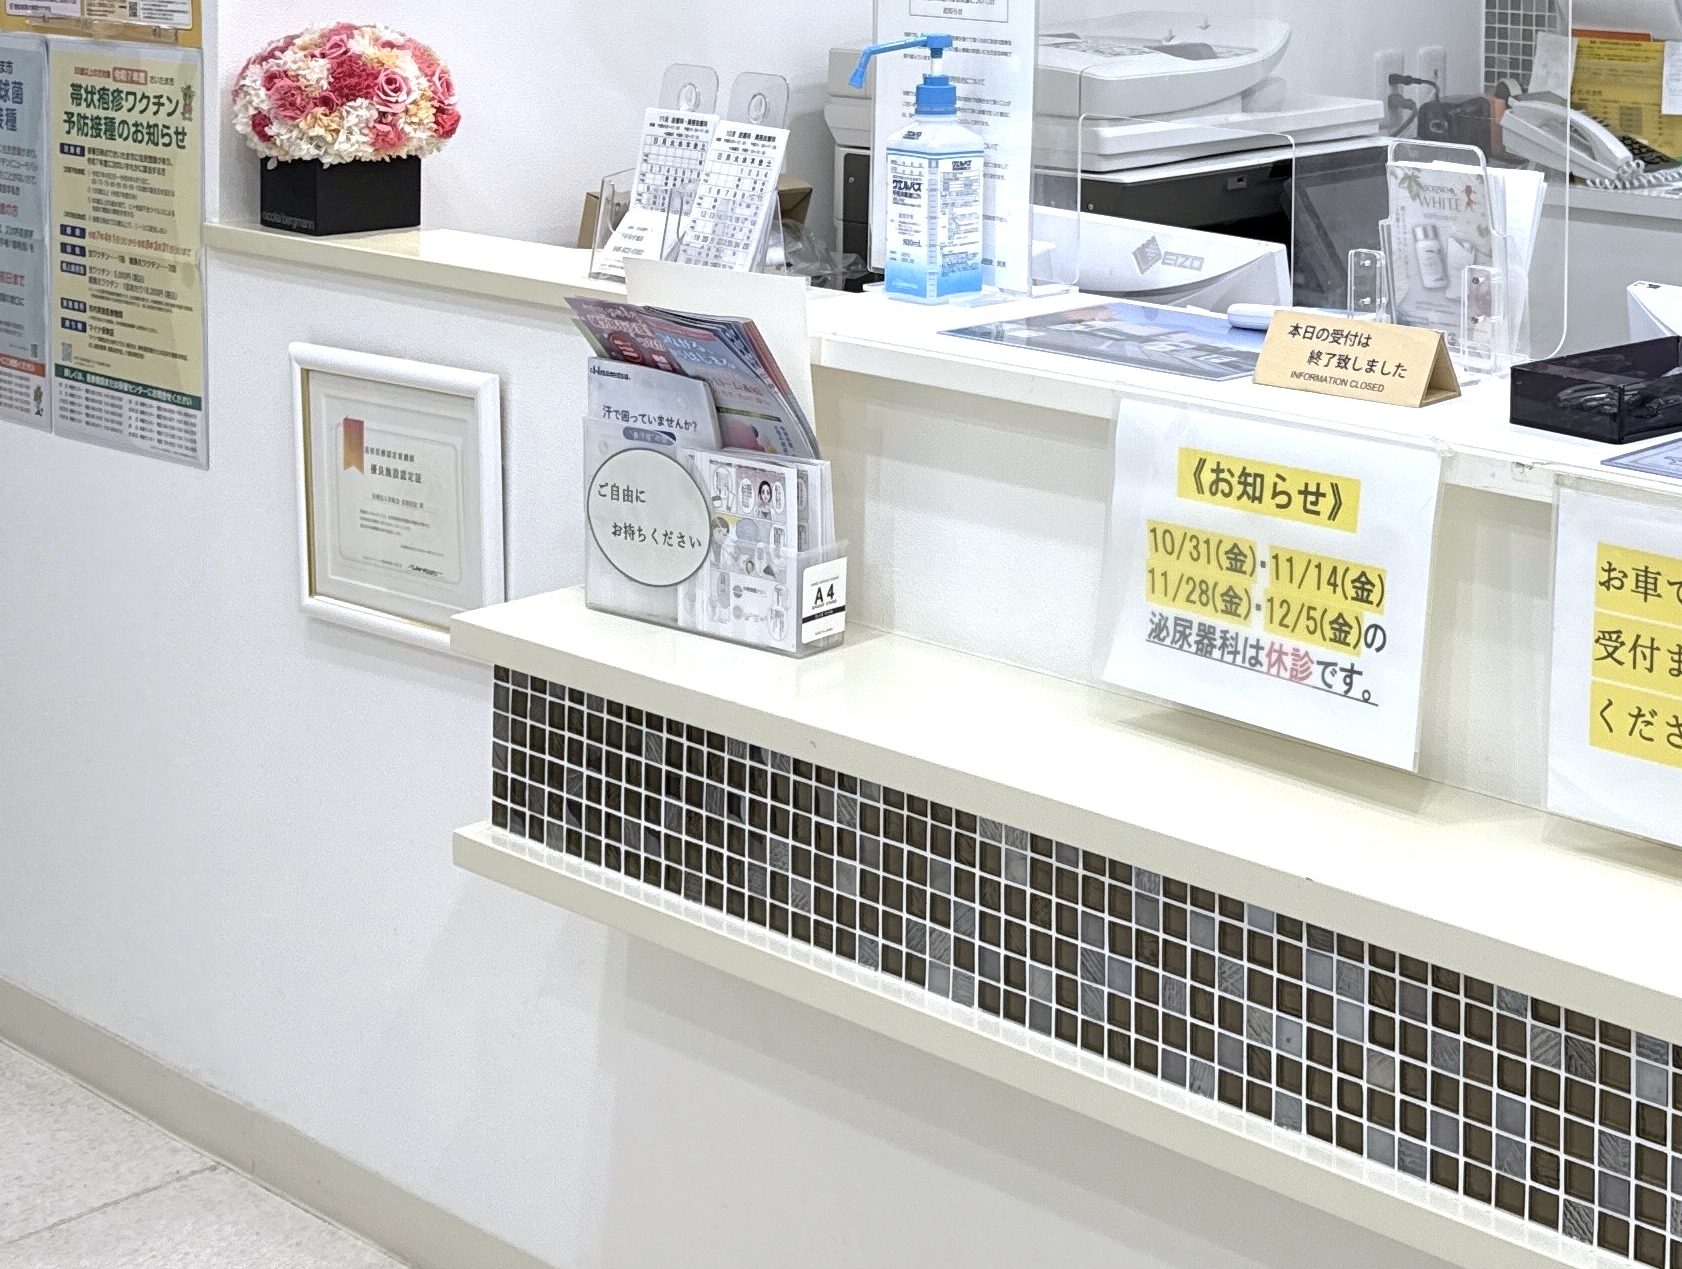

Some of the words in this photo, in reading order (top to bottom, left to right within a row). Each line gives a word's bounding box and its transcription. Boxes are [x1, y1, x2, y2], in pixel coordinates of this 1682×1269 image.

[70, 82, 179, 117] 帯状疱疹ワクチン
[63, 111, 188, 150] 予防接種のお知らせ
[1161, 251, 1204, 272] EIZO
[1288, 323, 1373, 348] 本日の受付は
[1306, 350, 1408, 379] 終了致しました
[1290, 370, 1348, 387] INFORMATION
[1349, 379, 1385, 393] CLOSED
[598, 483, 647, 504] ご自由に
[1193, 458, 1344, 522] 《お知らせ》
[611, 522, 702, 549] お持ちください
[1147, 611, 1373, 703] 泌尿器科は休診です。
